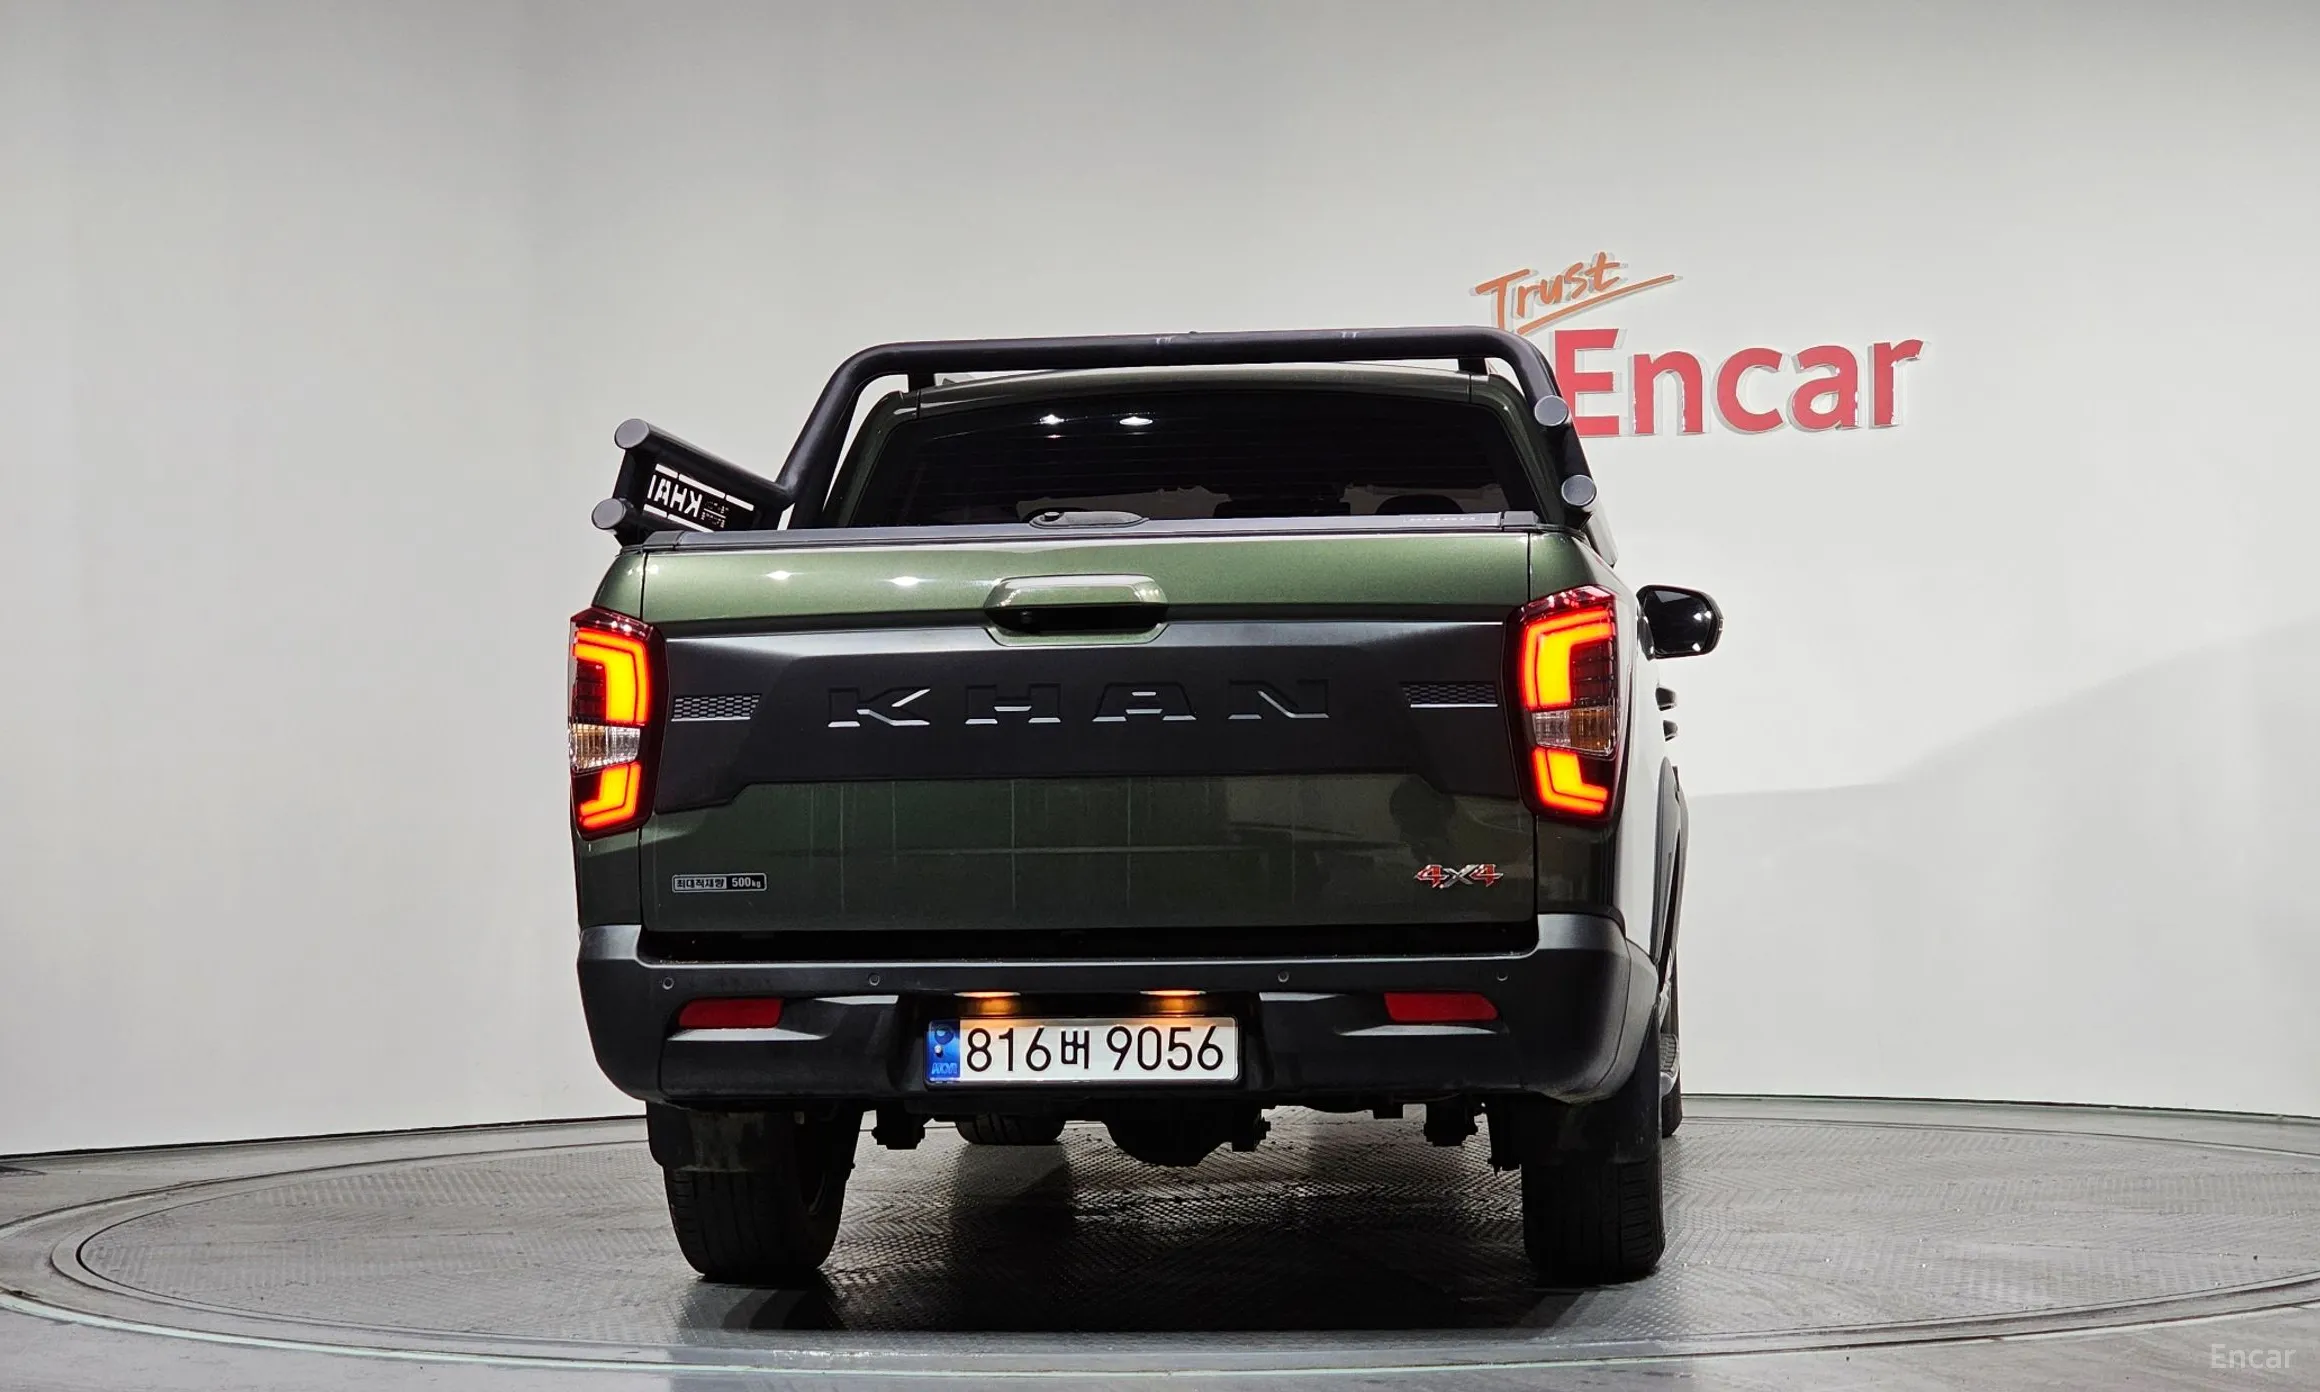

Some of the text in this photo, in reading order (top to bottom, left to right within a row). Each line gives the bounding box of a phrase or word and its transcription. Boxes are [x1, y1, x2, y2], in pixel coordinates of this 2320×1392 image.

[1475, 251, 1622, 331] Trust
[1555, 327, 1925, 437] Encar
[828, 681, 1330, 728] KHAN
[966, 1026, 1224, 1072] 816버 9056
